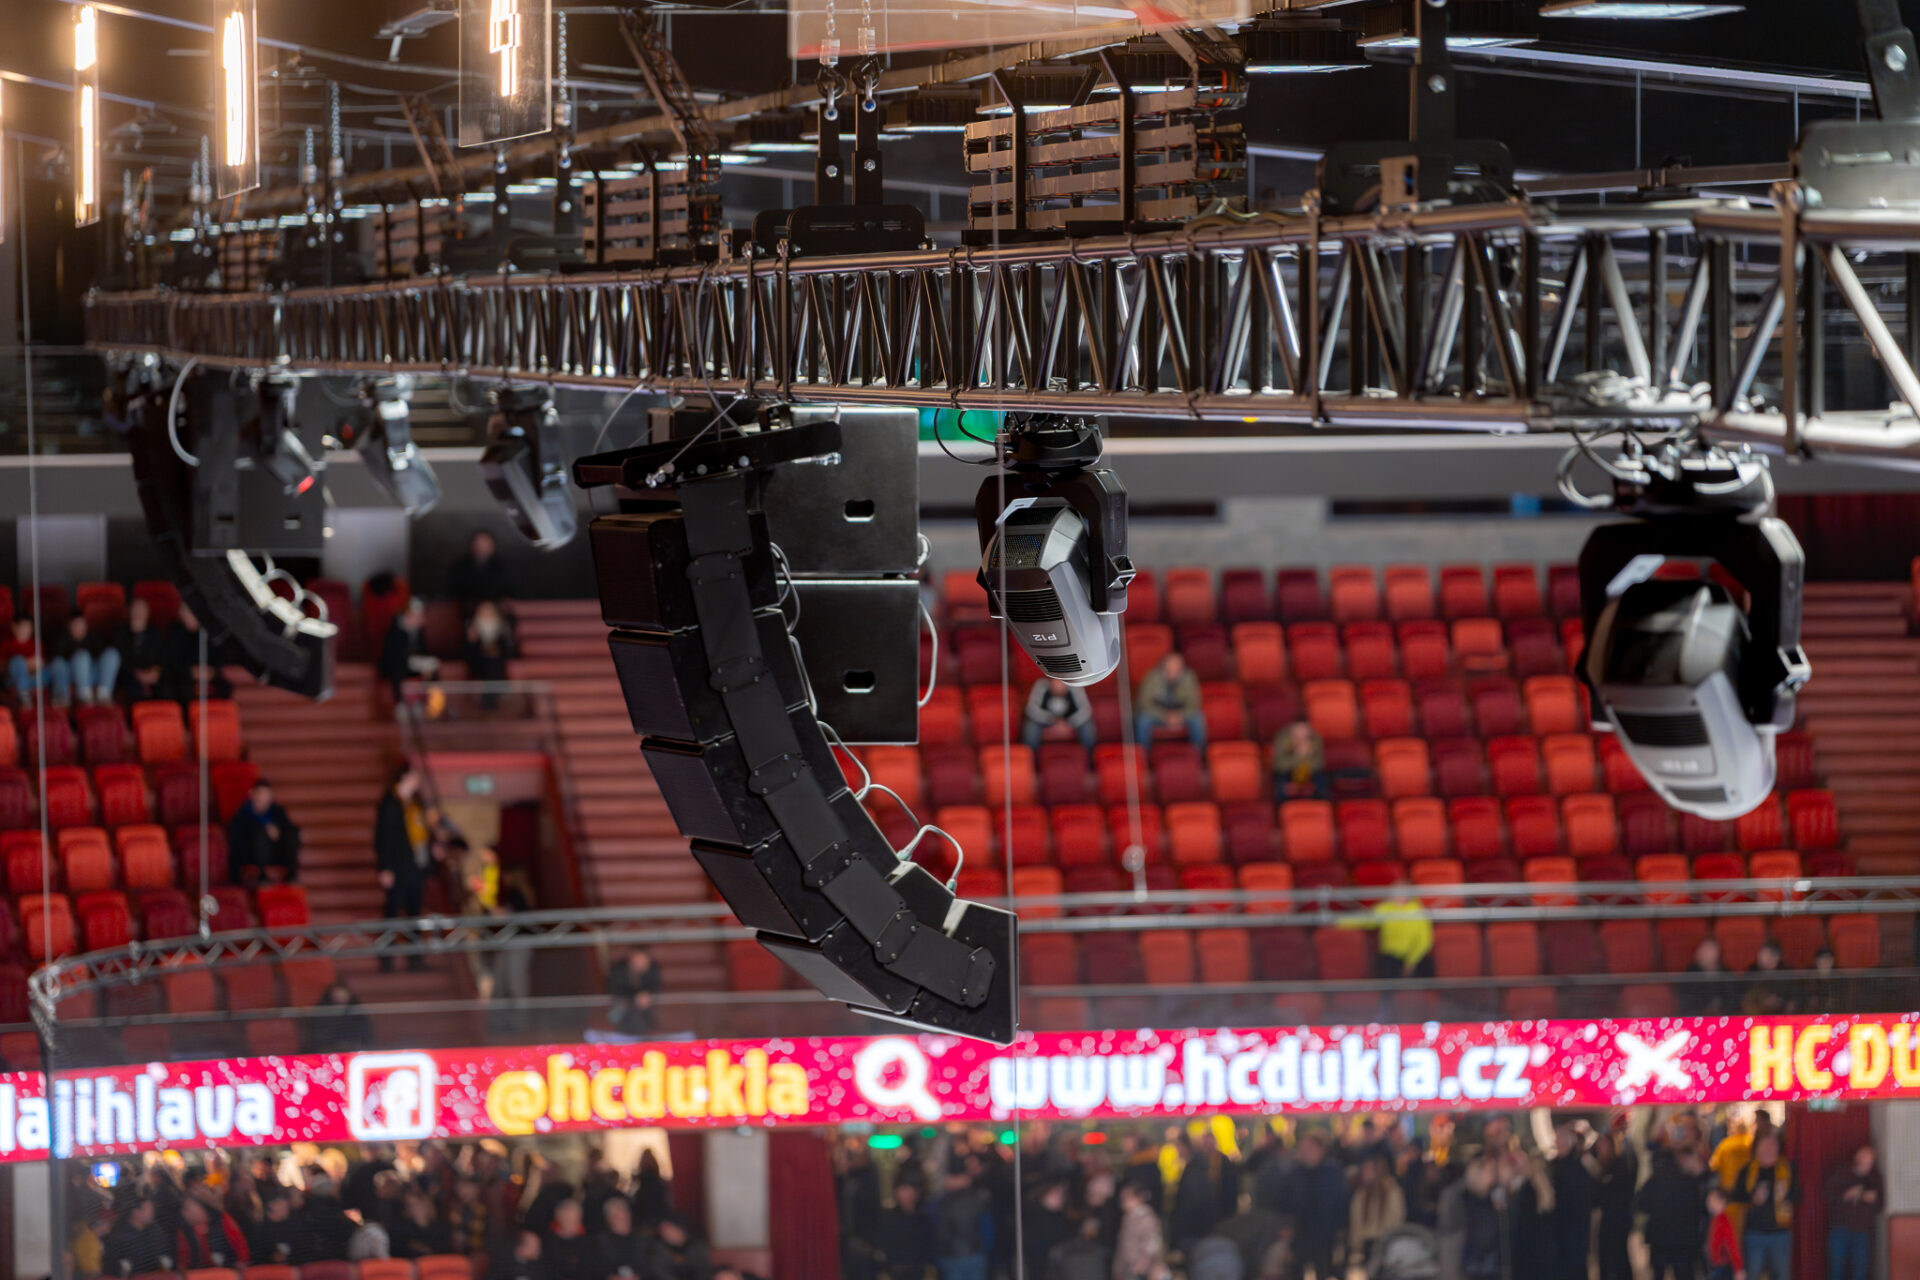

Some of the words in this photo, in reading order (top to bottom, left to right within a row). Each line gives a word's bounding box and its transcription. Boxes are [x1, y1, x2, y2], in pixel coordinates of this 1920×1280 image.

[1032, 633, 1058, 642] P12
[486, 1048, 809, 1135] @hcdukla
[990, 1034, 1531, 1110] www.hcdukla.cz
[1751, 1025, 1833, 1091] HC
